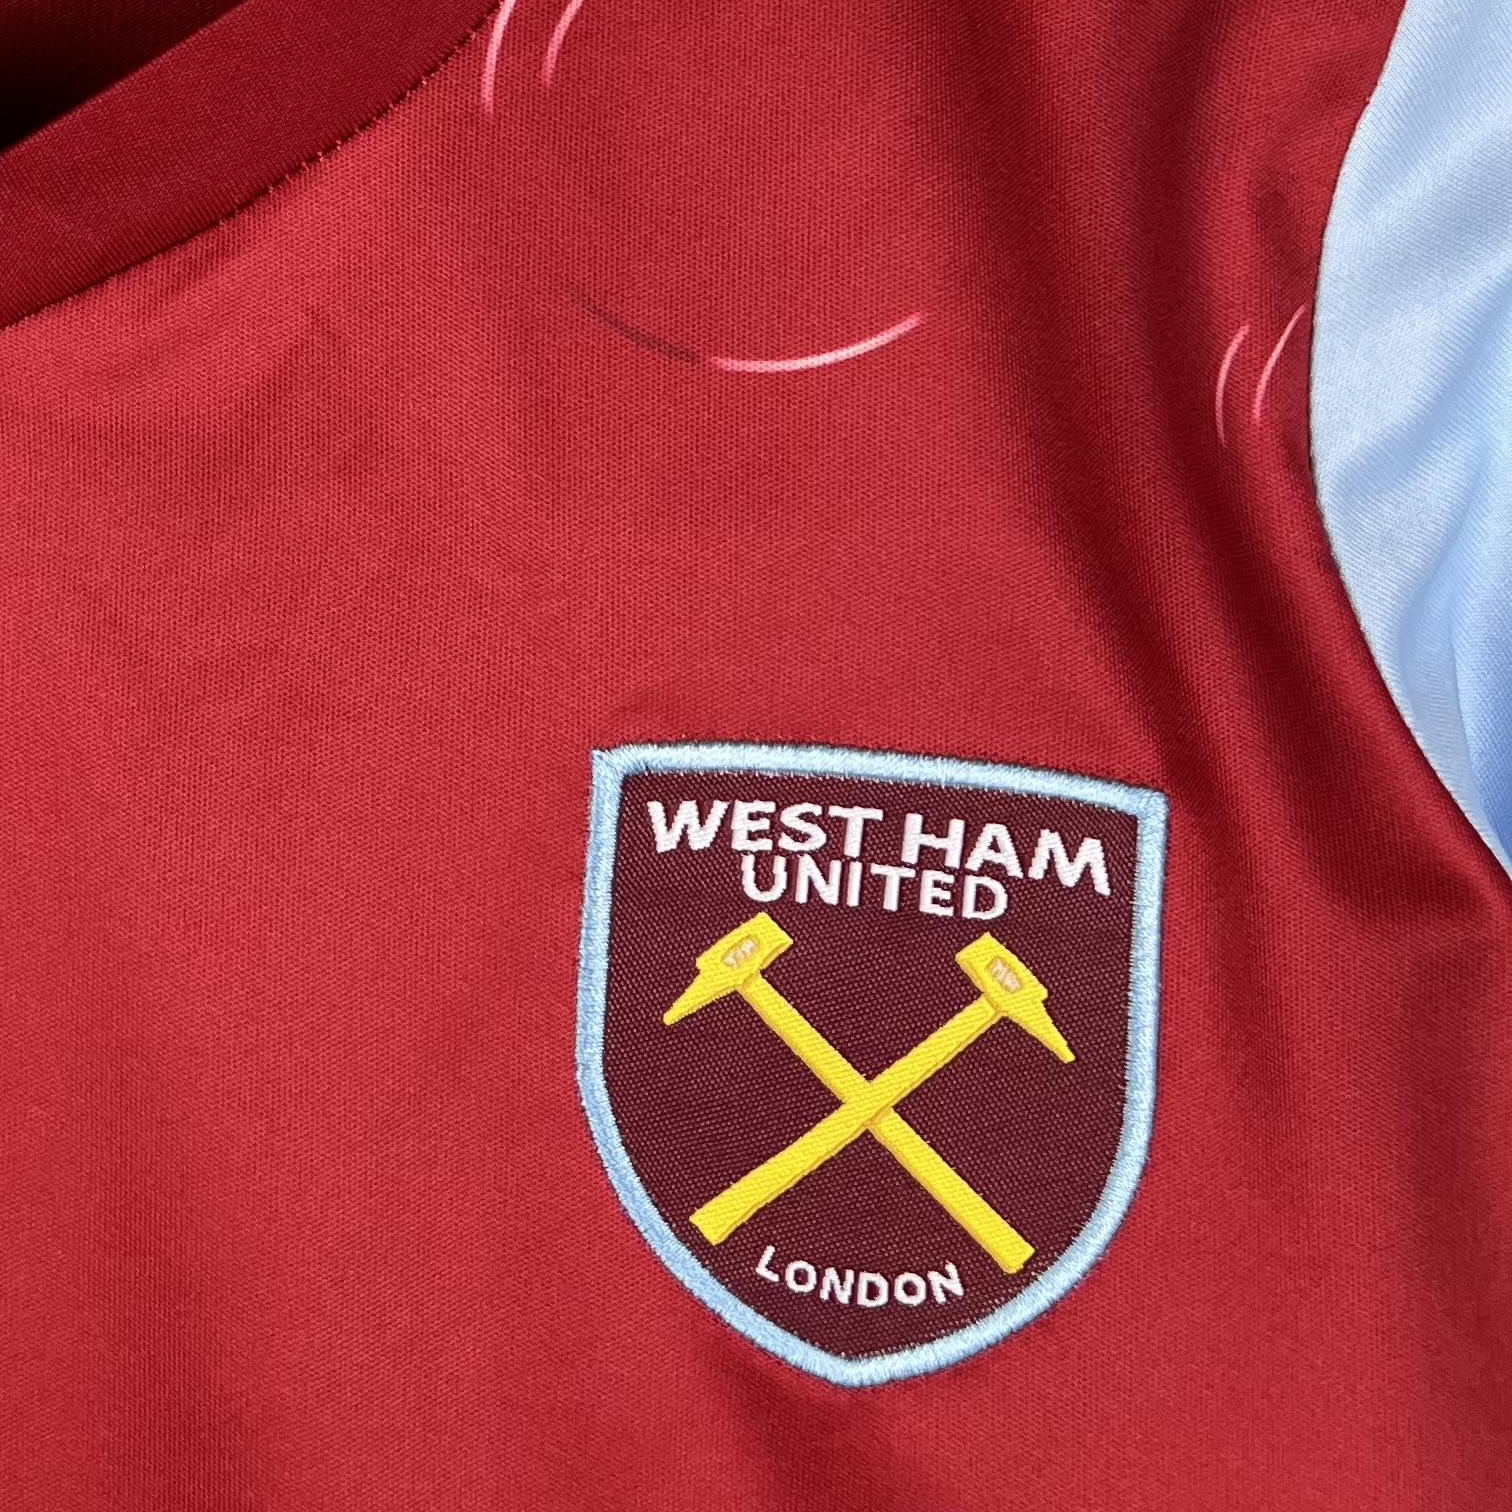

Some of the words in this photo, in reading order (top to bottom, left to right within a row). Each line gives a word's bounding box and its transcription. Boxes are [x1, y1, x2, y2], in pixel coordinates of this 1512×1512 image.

[646, 798, 884, 859] WEST
[900, 812, 1112, 898] HAM
[740, 851, 1009, 921] UNITED
[754, 1244, 965, 1308] LONDON
